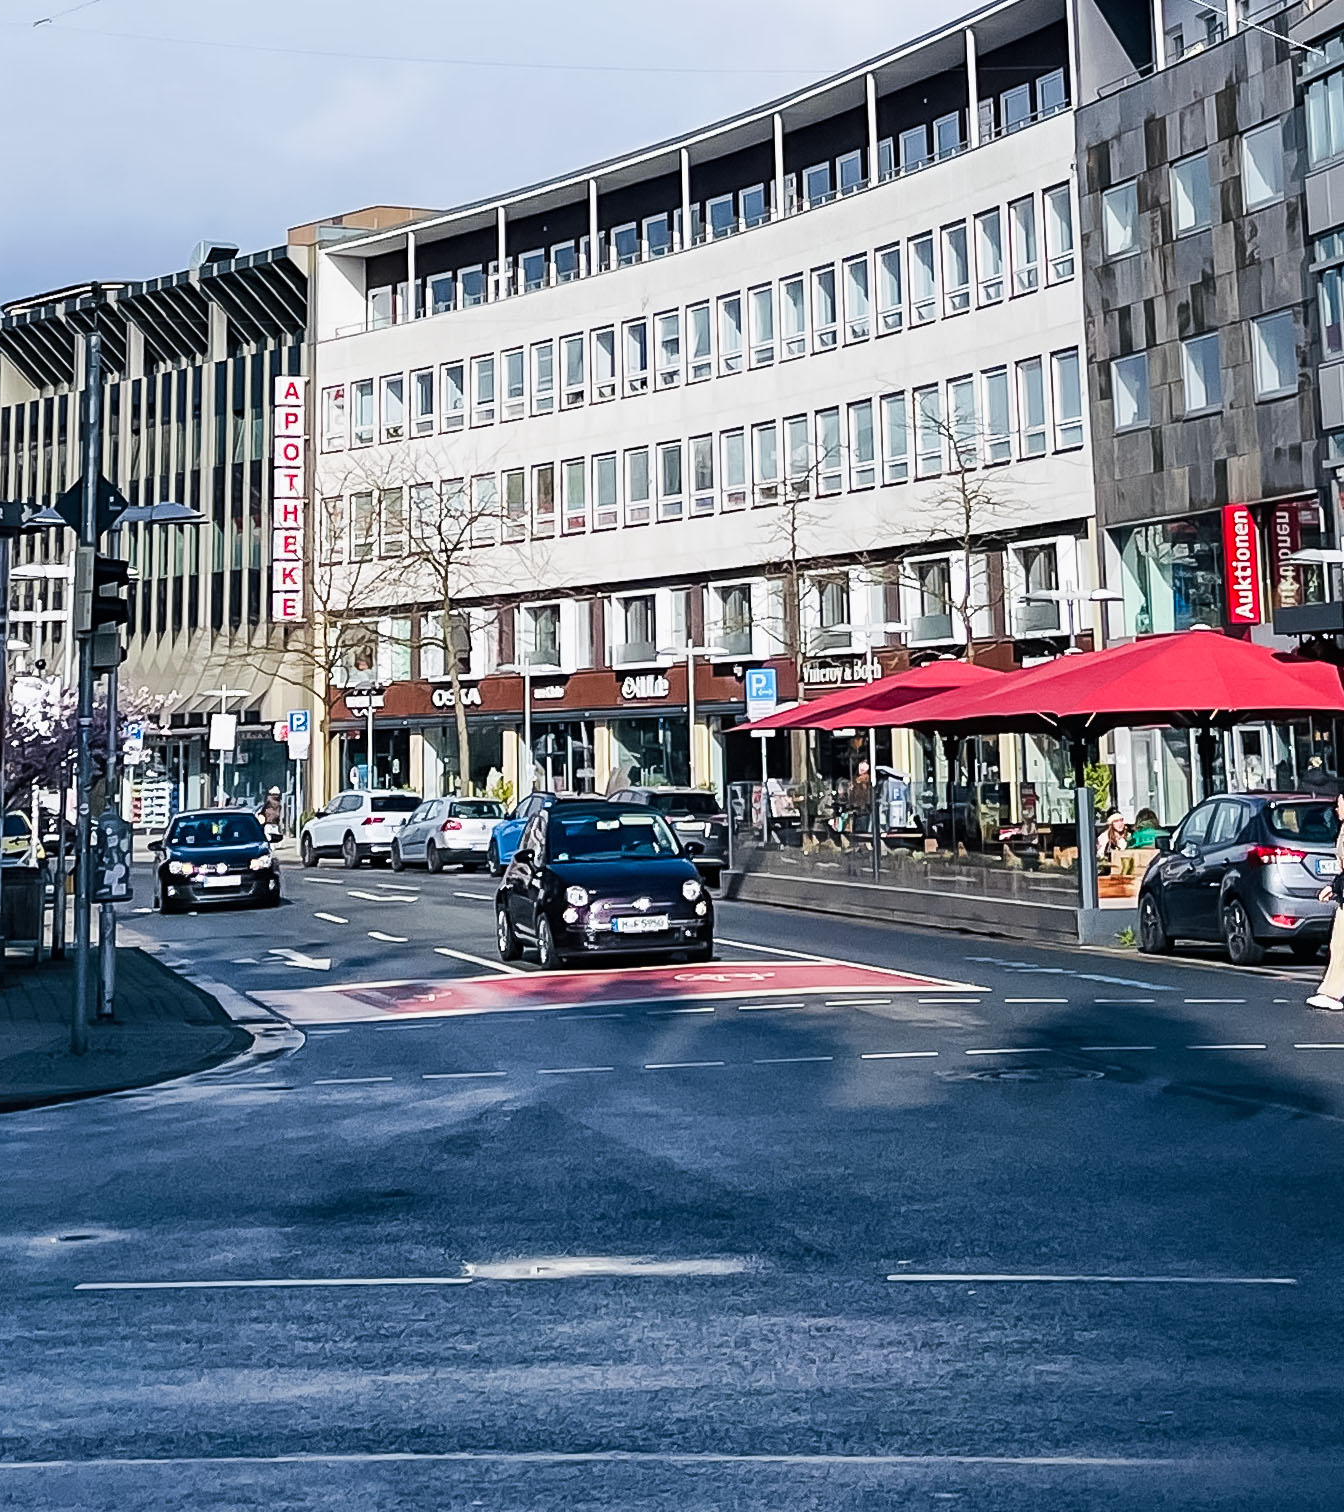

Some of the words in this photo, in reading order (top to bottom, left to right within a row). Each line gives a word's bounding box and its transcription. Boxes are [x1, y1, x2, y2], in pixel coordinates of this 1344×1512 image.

[280, 381, 301, 618] APOTHEKE
[1230, 510, 1255, 620] Auktionen
[751, 673, 767, 696] P
[292, 714, 306, 731] P
